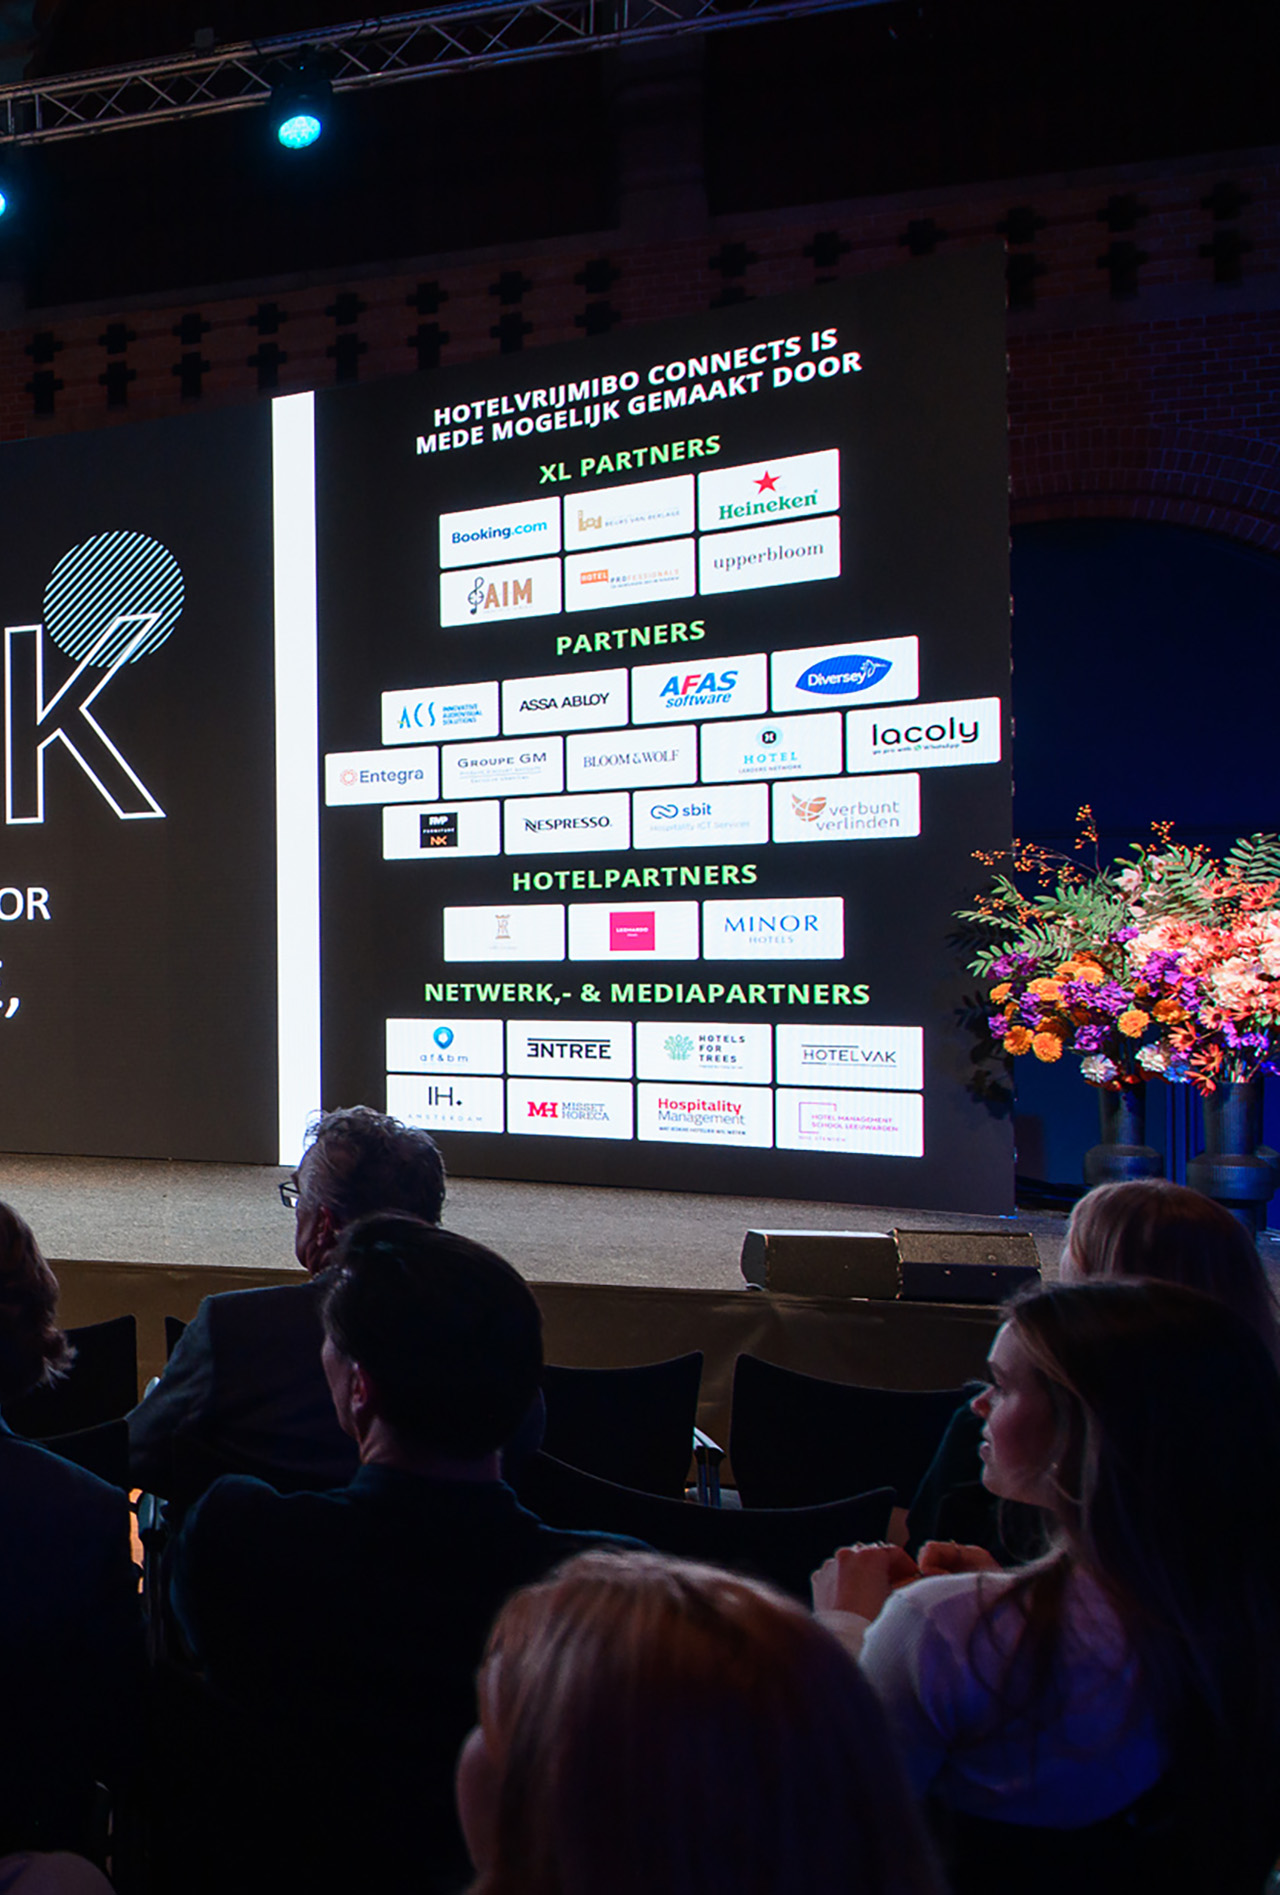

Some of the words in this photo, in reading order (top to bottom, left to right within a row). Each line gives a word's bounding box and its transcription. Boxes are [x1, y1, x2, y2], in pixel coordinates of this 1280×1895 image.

[433, 371, 640, 427] HOTELVRIJMIBO
[647, 336, 801, 386] CONNECTS
[810, 327, 839, 353] IS
[415, 425, 484, 455] MEDE
[491, 400, 621, 442] MOGELIJK
[627, 371, 765, 416] GEMAAKT
[772, 351, 863, 389] DOOR
[539, 463, 572, 484] XL
[580, 435, 722, 478] PARTNERS
[718, 491, 818, 520] Heineken
[451, 521, 548, 545] Booking.com
[713, 543, 824, 572] upperbloom
[483, 577, 533, 610] AIM
[556, 620, 706, 656] PARTNERS
[659, 670, 739, 698] AFAS
[807, 670, 868, 687] Diversey
[519, 698, 559, 712] ASSA
[561, 692, 610, 708] ABLOY
[665, 691, 732, 708] software
[398, 701, 437, 729] ACS
[872, 716, 979, 746] lacoly
[519, 752, 547, 764] GM
[743, 751, 798, 765] HOTEL
[360, 769, 424, 785] Entegra
[682, 803, 712, 816] sbit
[829, 801, 900, 817] verbunt
[816, 815, 900, 831] verlinden
[513, 864, 758, 891] HOTELPARTNERS
[723, 914, 819, 933] MINOR
[748, 935, 795, 944] HOTELS
[424, 983, 572, 1005] NETWERK,-
[580, 983, 602, 1003] &
[610, 983, 871, 1005] MEDIAPARTNERS
[698, 1034, 746, 1044] HOTELS
[698, 1044, 722, 1053] FOR
[698, 1053, 738, 1063] TREES
[561, 1102, 606, 1113] MISSET
[658, 1097, 742, 1115] Hospitality
[561, 1111, 610, 1122] HORECA
[658, 1109, 746, 1126] Management
